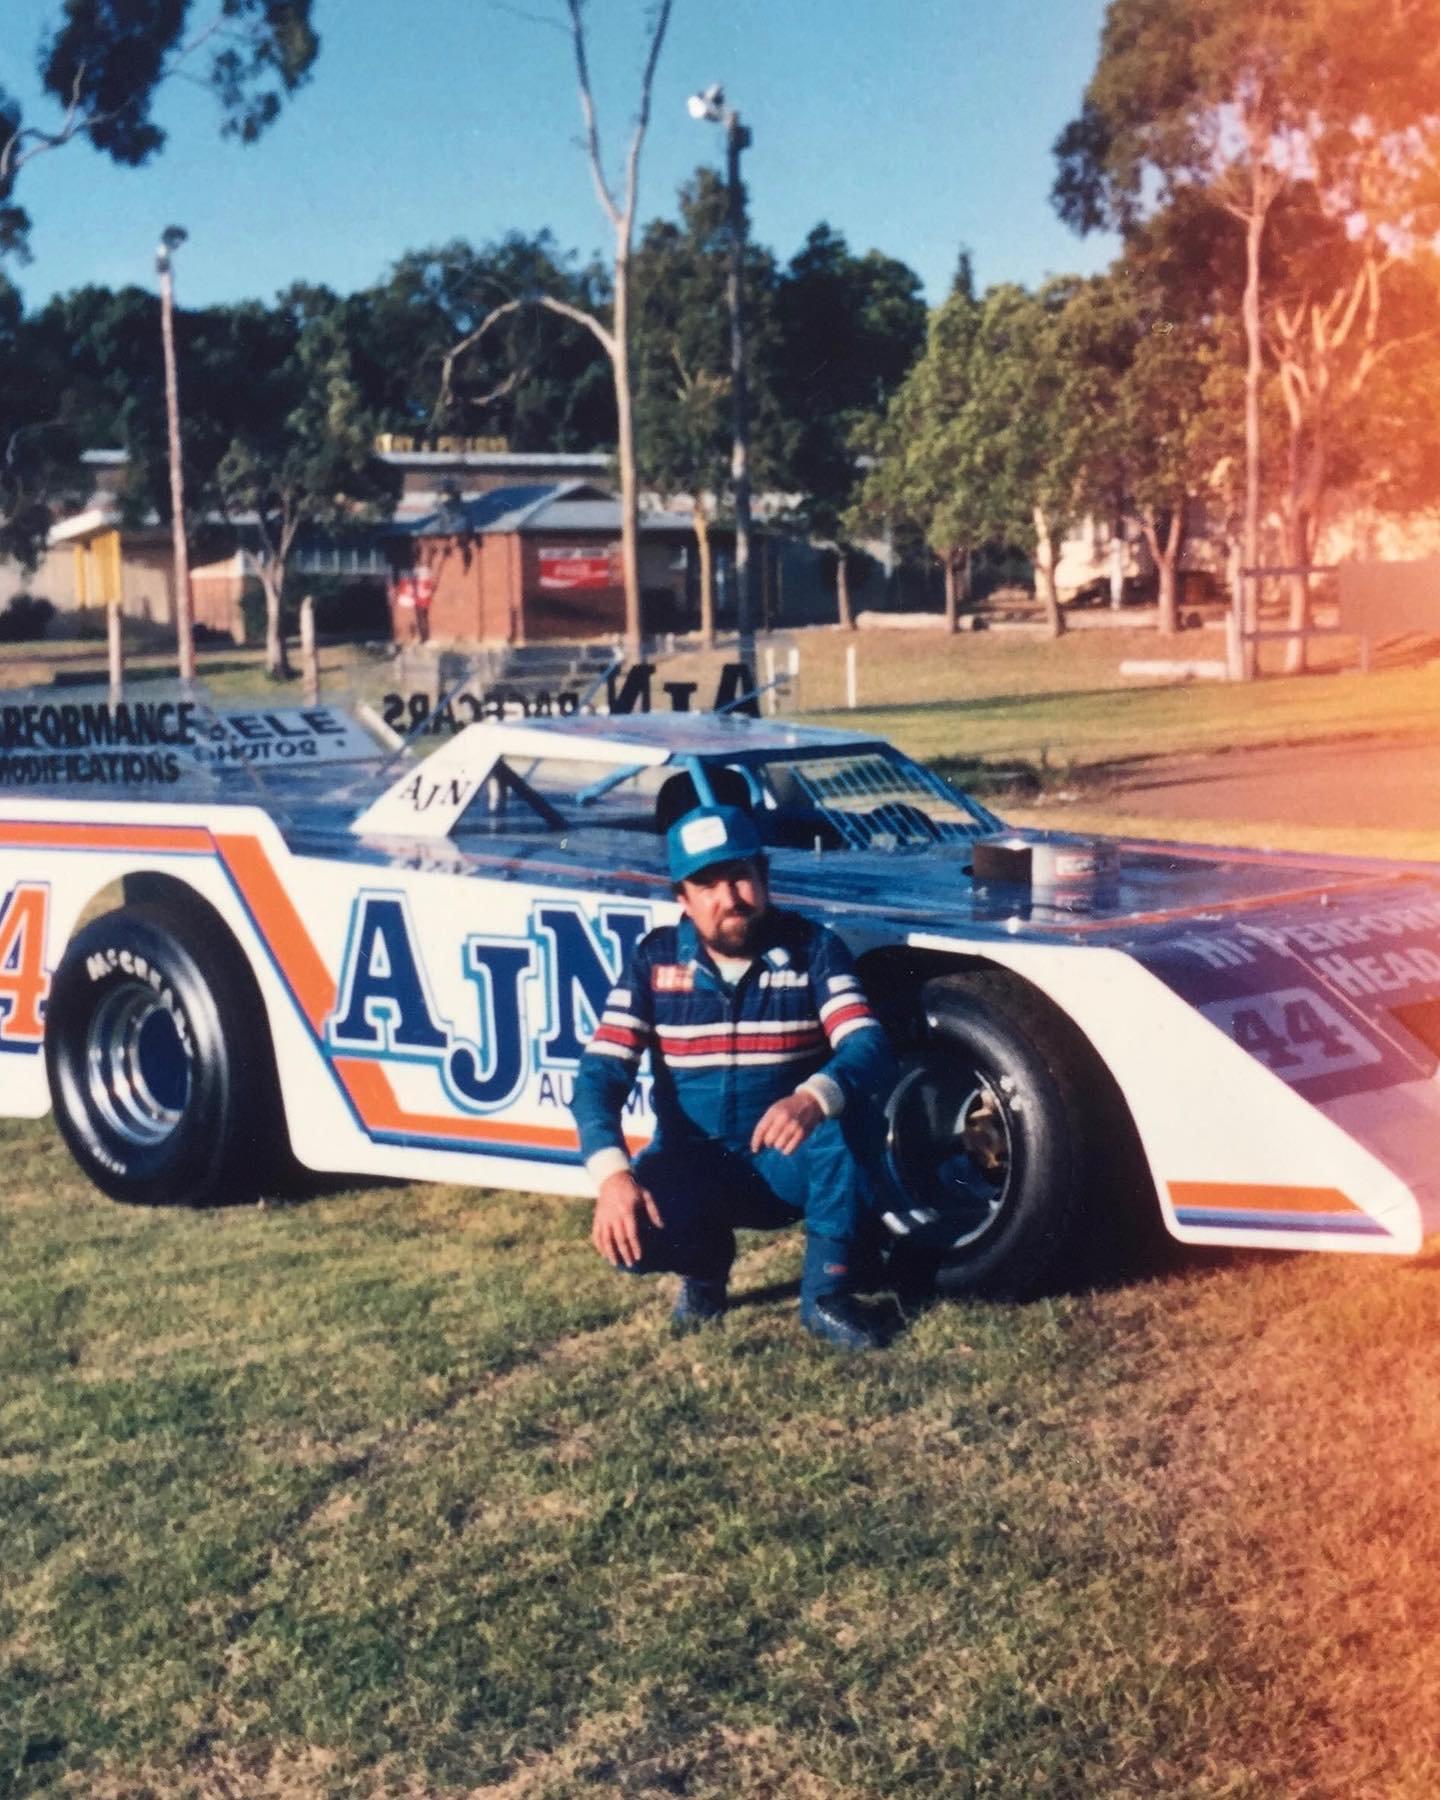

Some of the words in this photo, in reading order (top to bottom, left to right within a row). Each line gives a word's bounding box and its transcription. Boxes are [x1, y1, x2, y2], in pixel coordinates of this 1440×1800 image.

[399, 774, 471, 811] AJN
[325, 889, 654, 1114] AJN
[1231, 1000, 1356, 1068] 44
